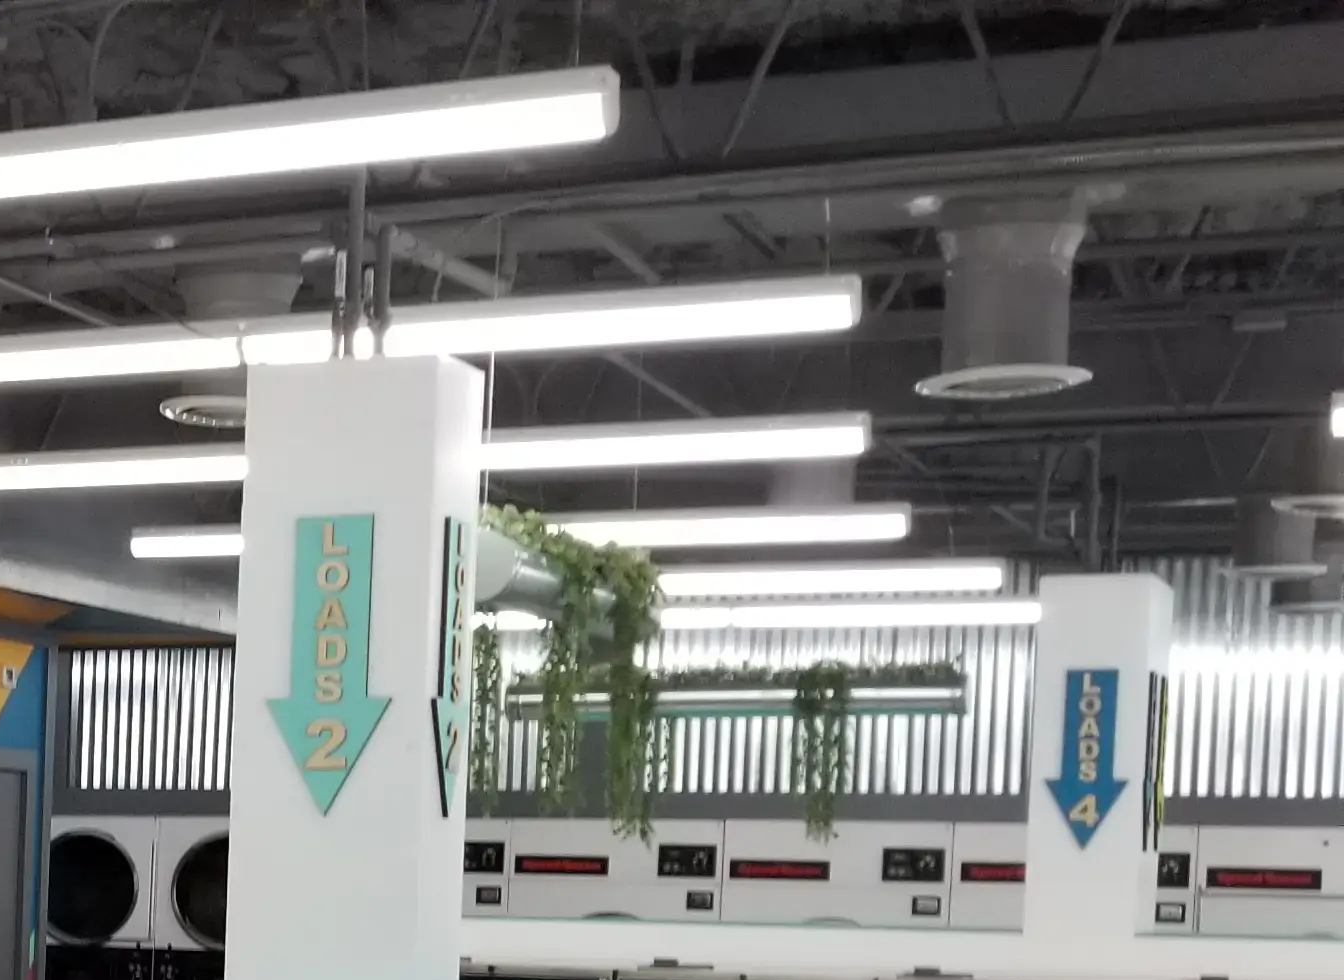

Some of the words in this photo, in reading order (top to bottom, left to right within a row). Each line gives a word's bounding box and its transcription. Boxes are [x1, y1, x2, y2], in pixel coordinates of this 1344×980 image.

[315, 521, 350, 704] LOADS
[304, 718, 348, 771] 2
[1078, 671, 1102, 783] LOADS
[1068, 793, 1099, 828] 4
